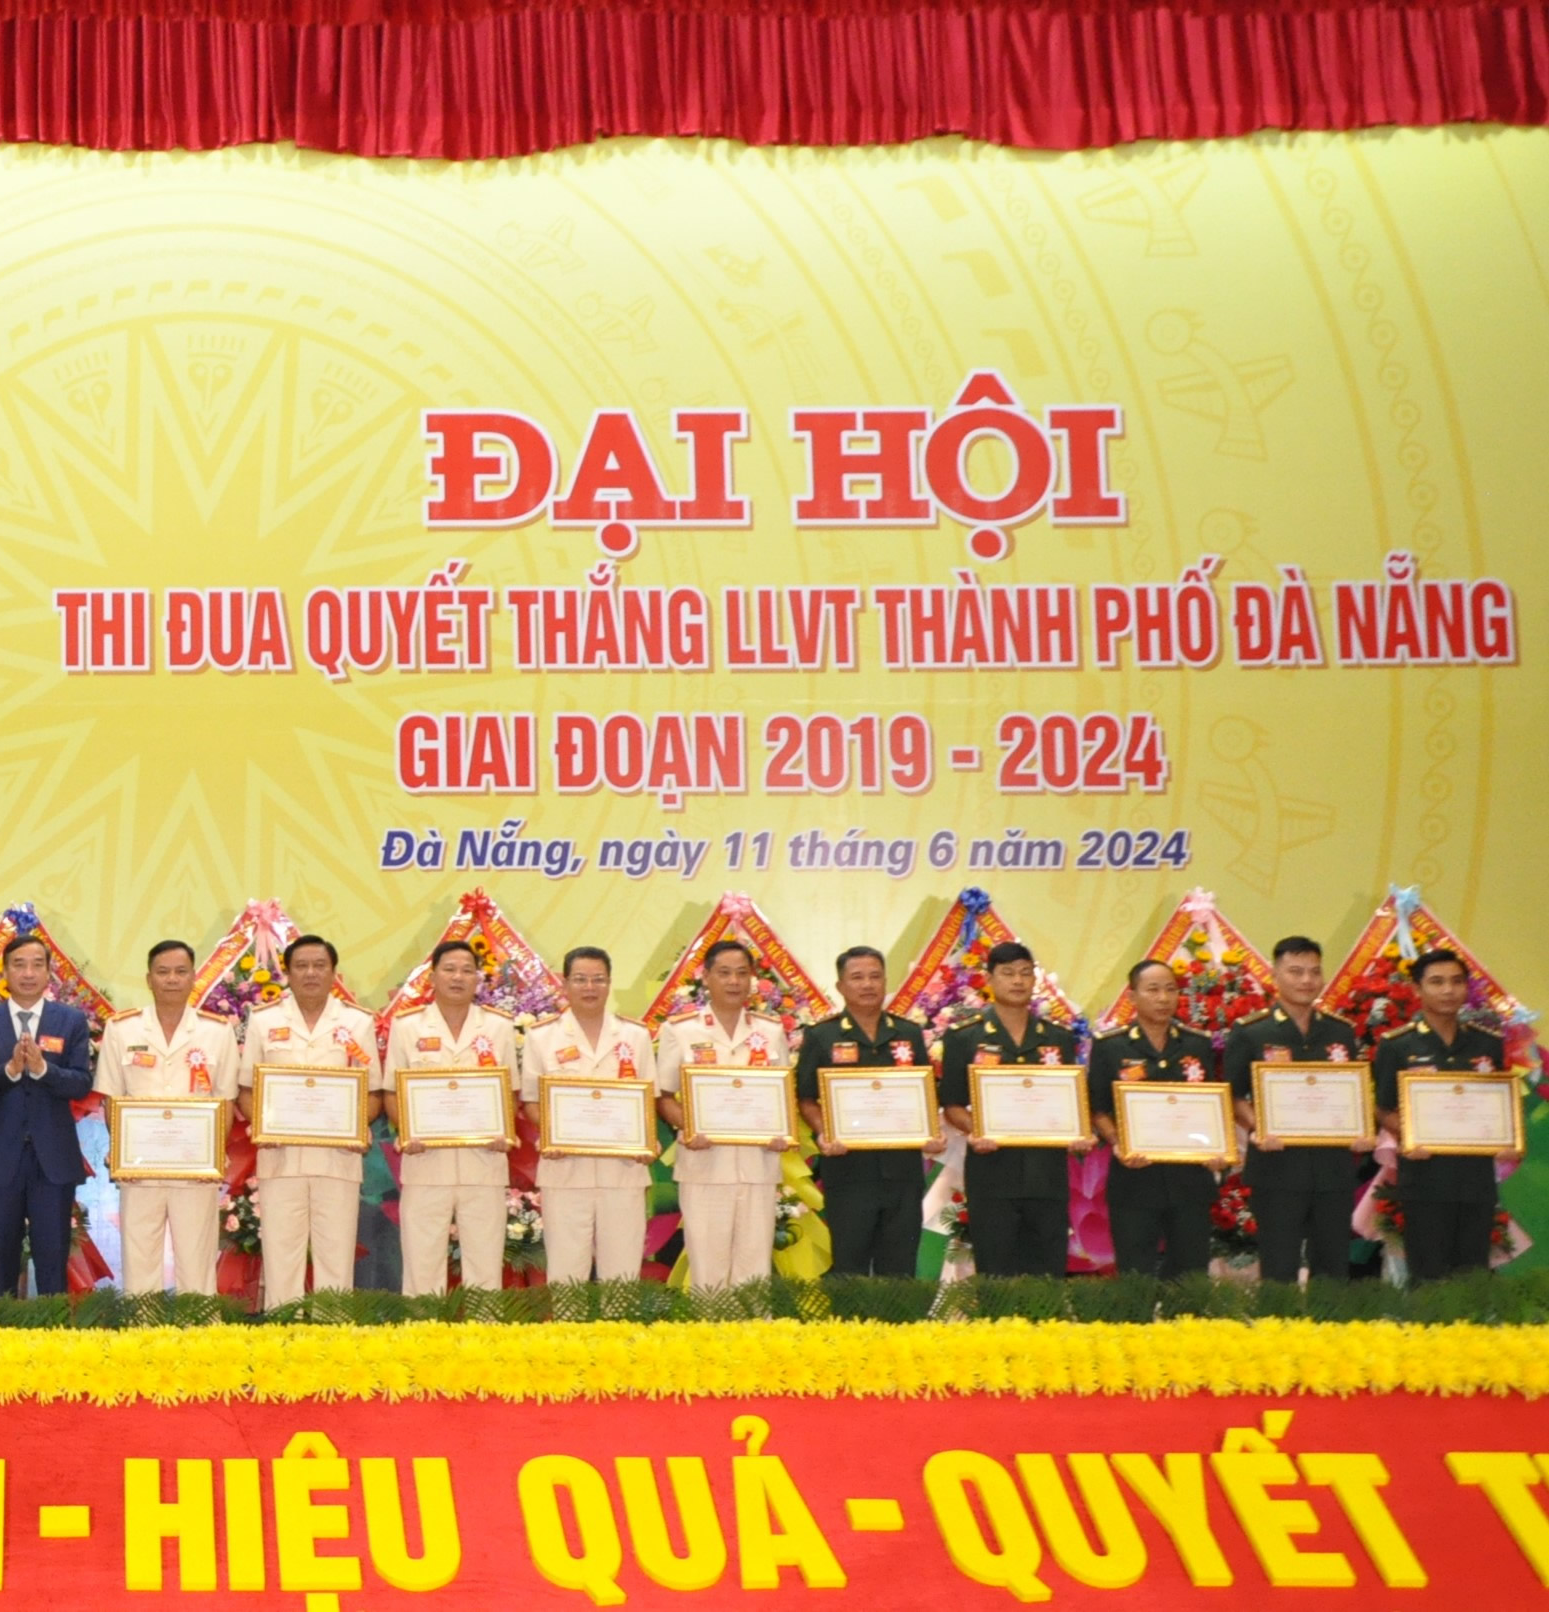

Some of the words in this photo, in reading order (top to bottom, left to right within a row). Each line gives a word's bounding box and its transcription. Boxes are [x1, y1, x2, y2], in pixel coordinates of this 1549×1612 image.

[424, 408, 748, 555] ĐẠI
[792, 370, 1123, 560] HỘI
[54, 589, 148, 669] THI
[164, 589, 289, 669] ĐUA
[305, 560, 492, 677] QUYẾT
[506, 559, 707, 668] THẮNG
[724, 587, 859, 667] LLVT
[873, 569, 1076, 667] THÀNH
[1093, 556, 1216, 665] PHỐ
[1232, 566, 1319, 664] ĐÀ
[1334, 551, 1512, 662] NẴNG
[397, 713, 534, 790] GIAI
[553, 713, 743, 807] ĐOẠN
[764, 713, 929, 790] 2019
[951, 747, 978, 768] -
[998, 713, 1167, 790] 2024
[380, 828, 444, 869] Đà
[455, 817, 583, 877] Nẵng,
[598, 828, 708, 877] ngày
[726, 830, 770, 868] 11
[789, 828, 915, 877] tháng
[928, 830, 956, 868] 6
[969, 828, 1064, 868] năm
[1077, 829, 1190, 869] 2024
[122, 1430, 464, 1612] HIỆU
[516, 1414, 849, 1607] QUẢ
[922, 1409, 1430, 1603] QUYẾT
